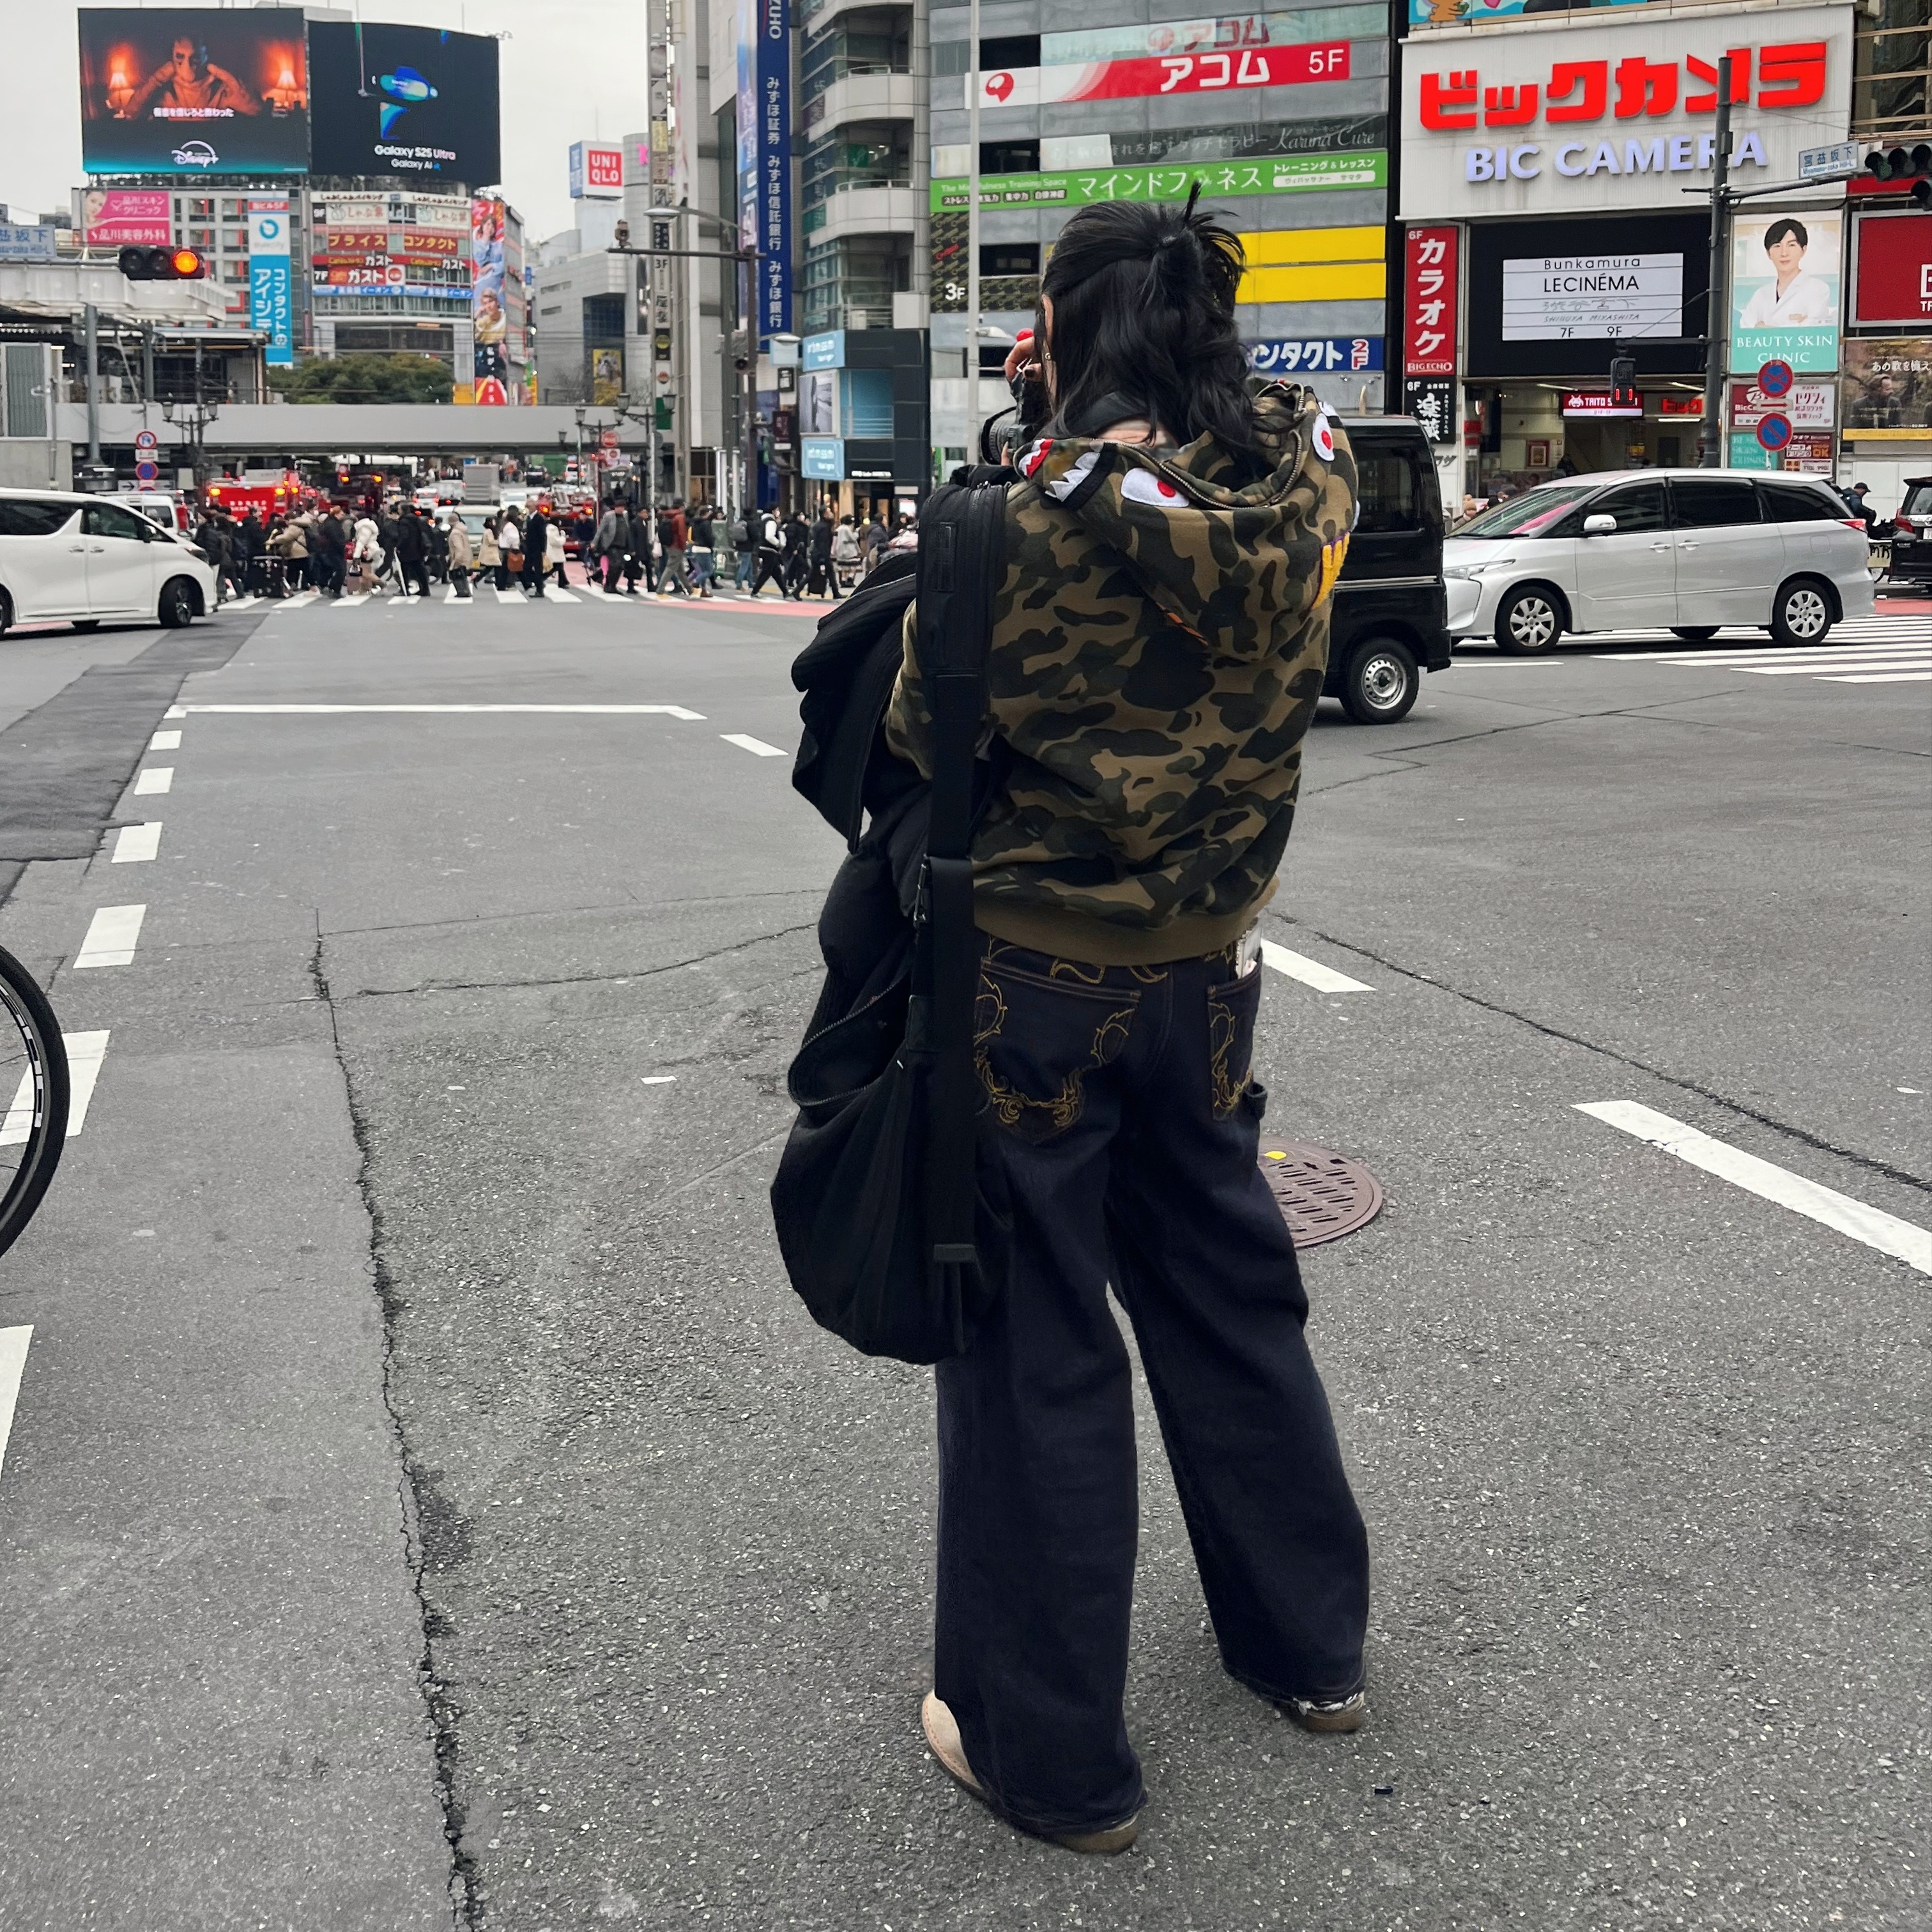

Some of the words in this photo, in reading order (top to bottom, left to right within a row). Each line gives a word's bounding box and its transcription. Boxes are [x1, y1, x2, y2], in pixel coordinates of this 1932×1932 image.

[1160, 50, 1271, 92] アコム
[1308, 49, 1344, 74] 5F
[1420, 42, 1827, 130] ビックカメラ
[767, 77, 781, 144] みずほ証券
[374, 144, 414, 158] Galaxy
[415, 147, 433, 157] S25
[433, 149, 456, 160] Ultra
[391, 158, 423, 171] Galaxy
[424, 161, 433, 169] AI
[592, 154, 617, 168] UNI
[1274, 160, 1328, 174] トレーニング
[1340, 158, 1376, 169] レッスン
[1466, 144, 1542, 182] BIC
[592, 169, 619, 183] QLO
[1078, 167, 1262, 199] マインドフネス
[768, 155, 782, 250] みずほ信託銀行
[99, 229, 166, 241] 品川美容外科
[1408, 231, 1423, 240] 6F
[404, 236, 456, 250] コンタクト
[365, 256, 394, 267] ガスト
[442, 259, 466, 271] ガスト
[1544, 257, 1641, 270] Bunkamura
[348, 269, 383, 284] ガスト
[769, 260, 783, 328] みずほ銀行
[945, 283, 966, 301] 3F
[1414, 238, 1446, 356] カラオケ
[1561, 327, 1575, 337] 7F
[1607, 326, 1622, 337] 9F
[1736, 335, 1793, 348] BEAUTY
[1797, 334, 1834, 346] SKIN
[1584, 397, 1606, 406] TAITO
